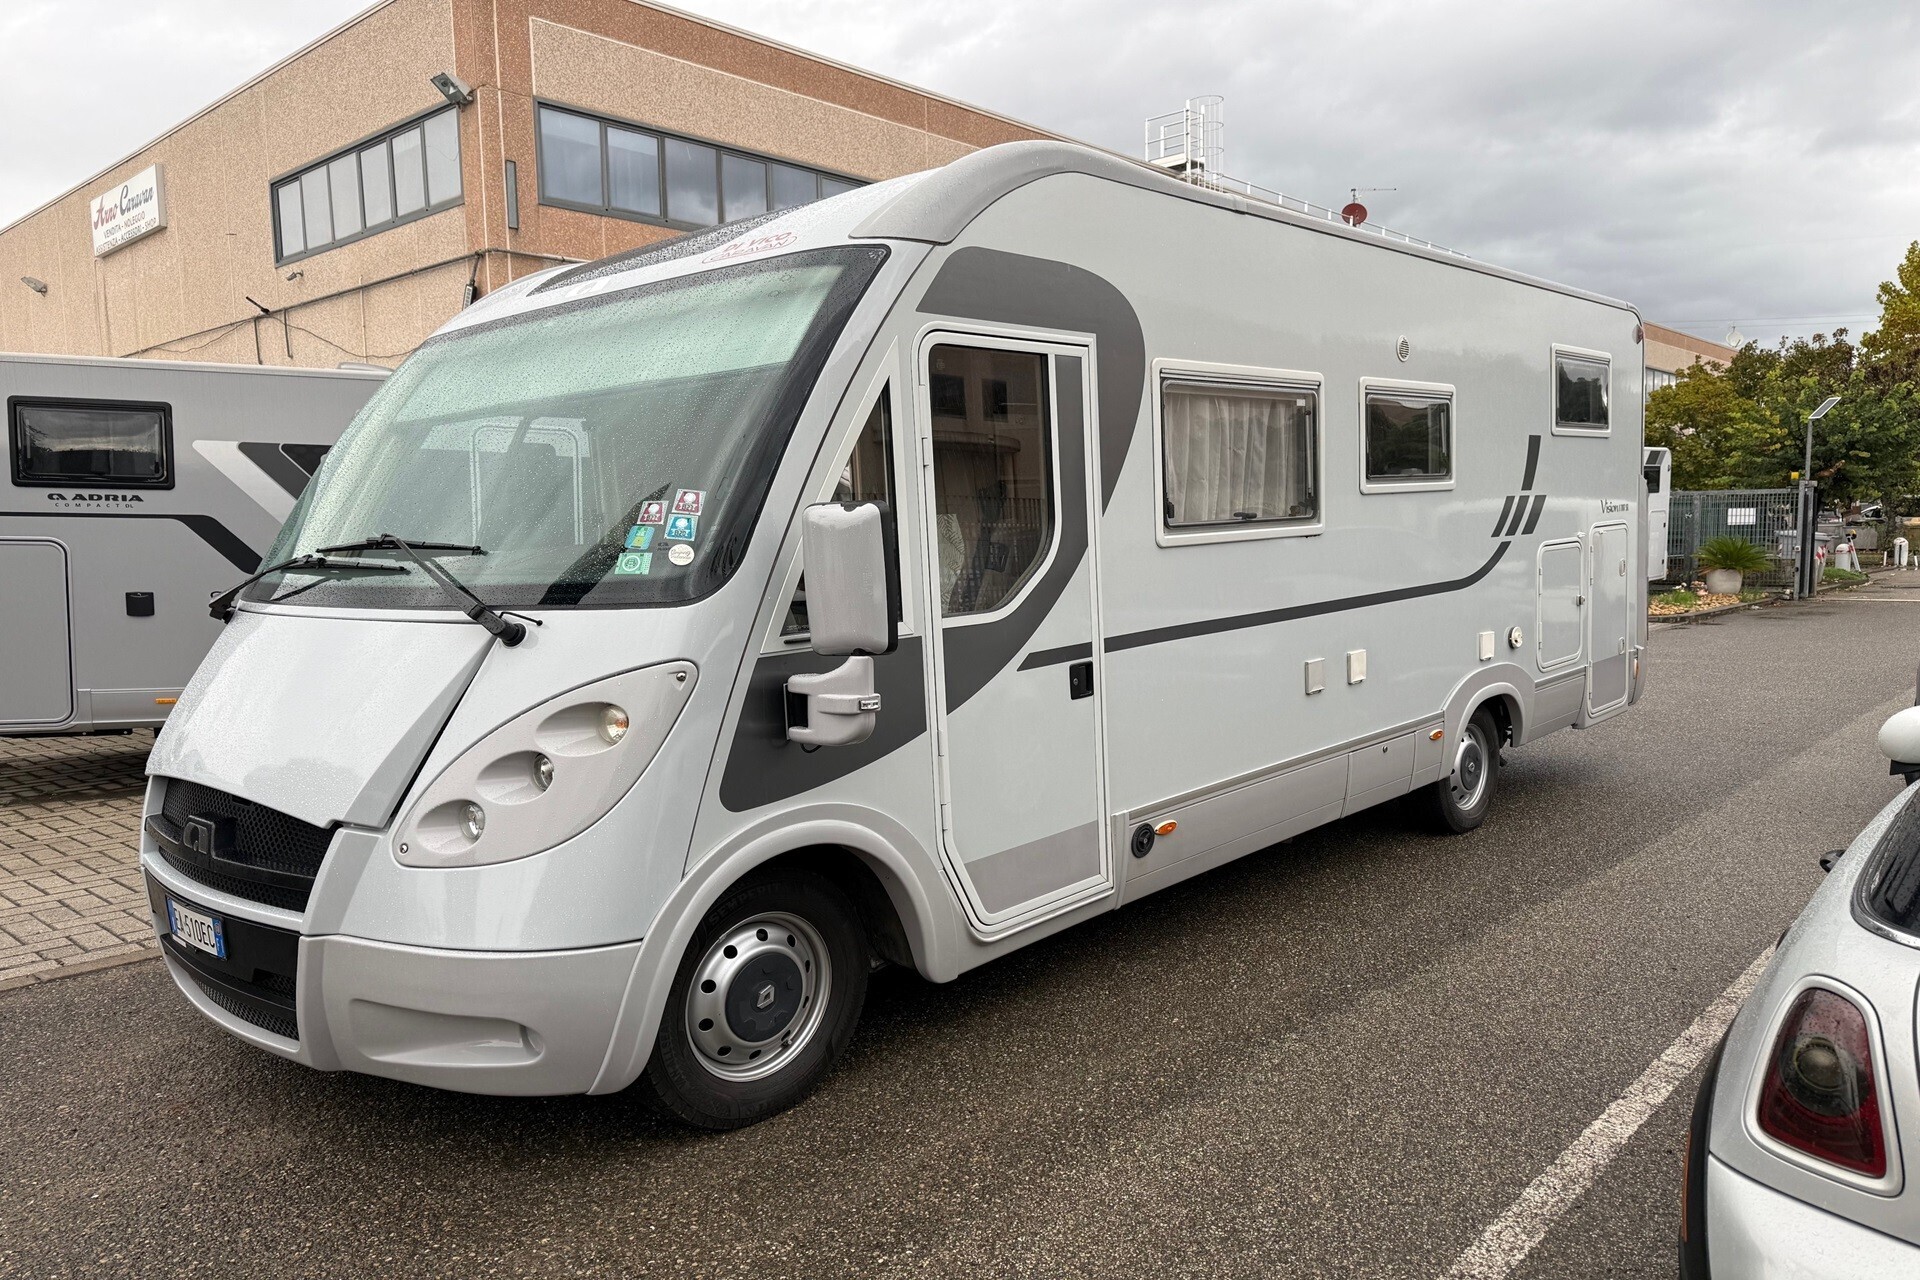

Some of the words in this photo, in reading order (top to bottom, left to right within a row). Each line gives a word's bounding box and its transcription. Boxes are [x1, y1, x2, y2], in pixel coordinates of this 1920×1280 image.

[94, 195, 119, 230] Arno
[120, 184, 154, 216] Caravan
[71, 493, 144, 502] ADRIA
